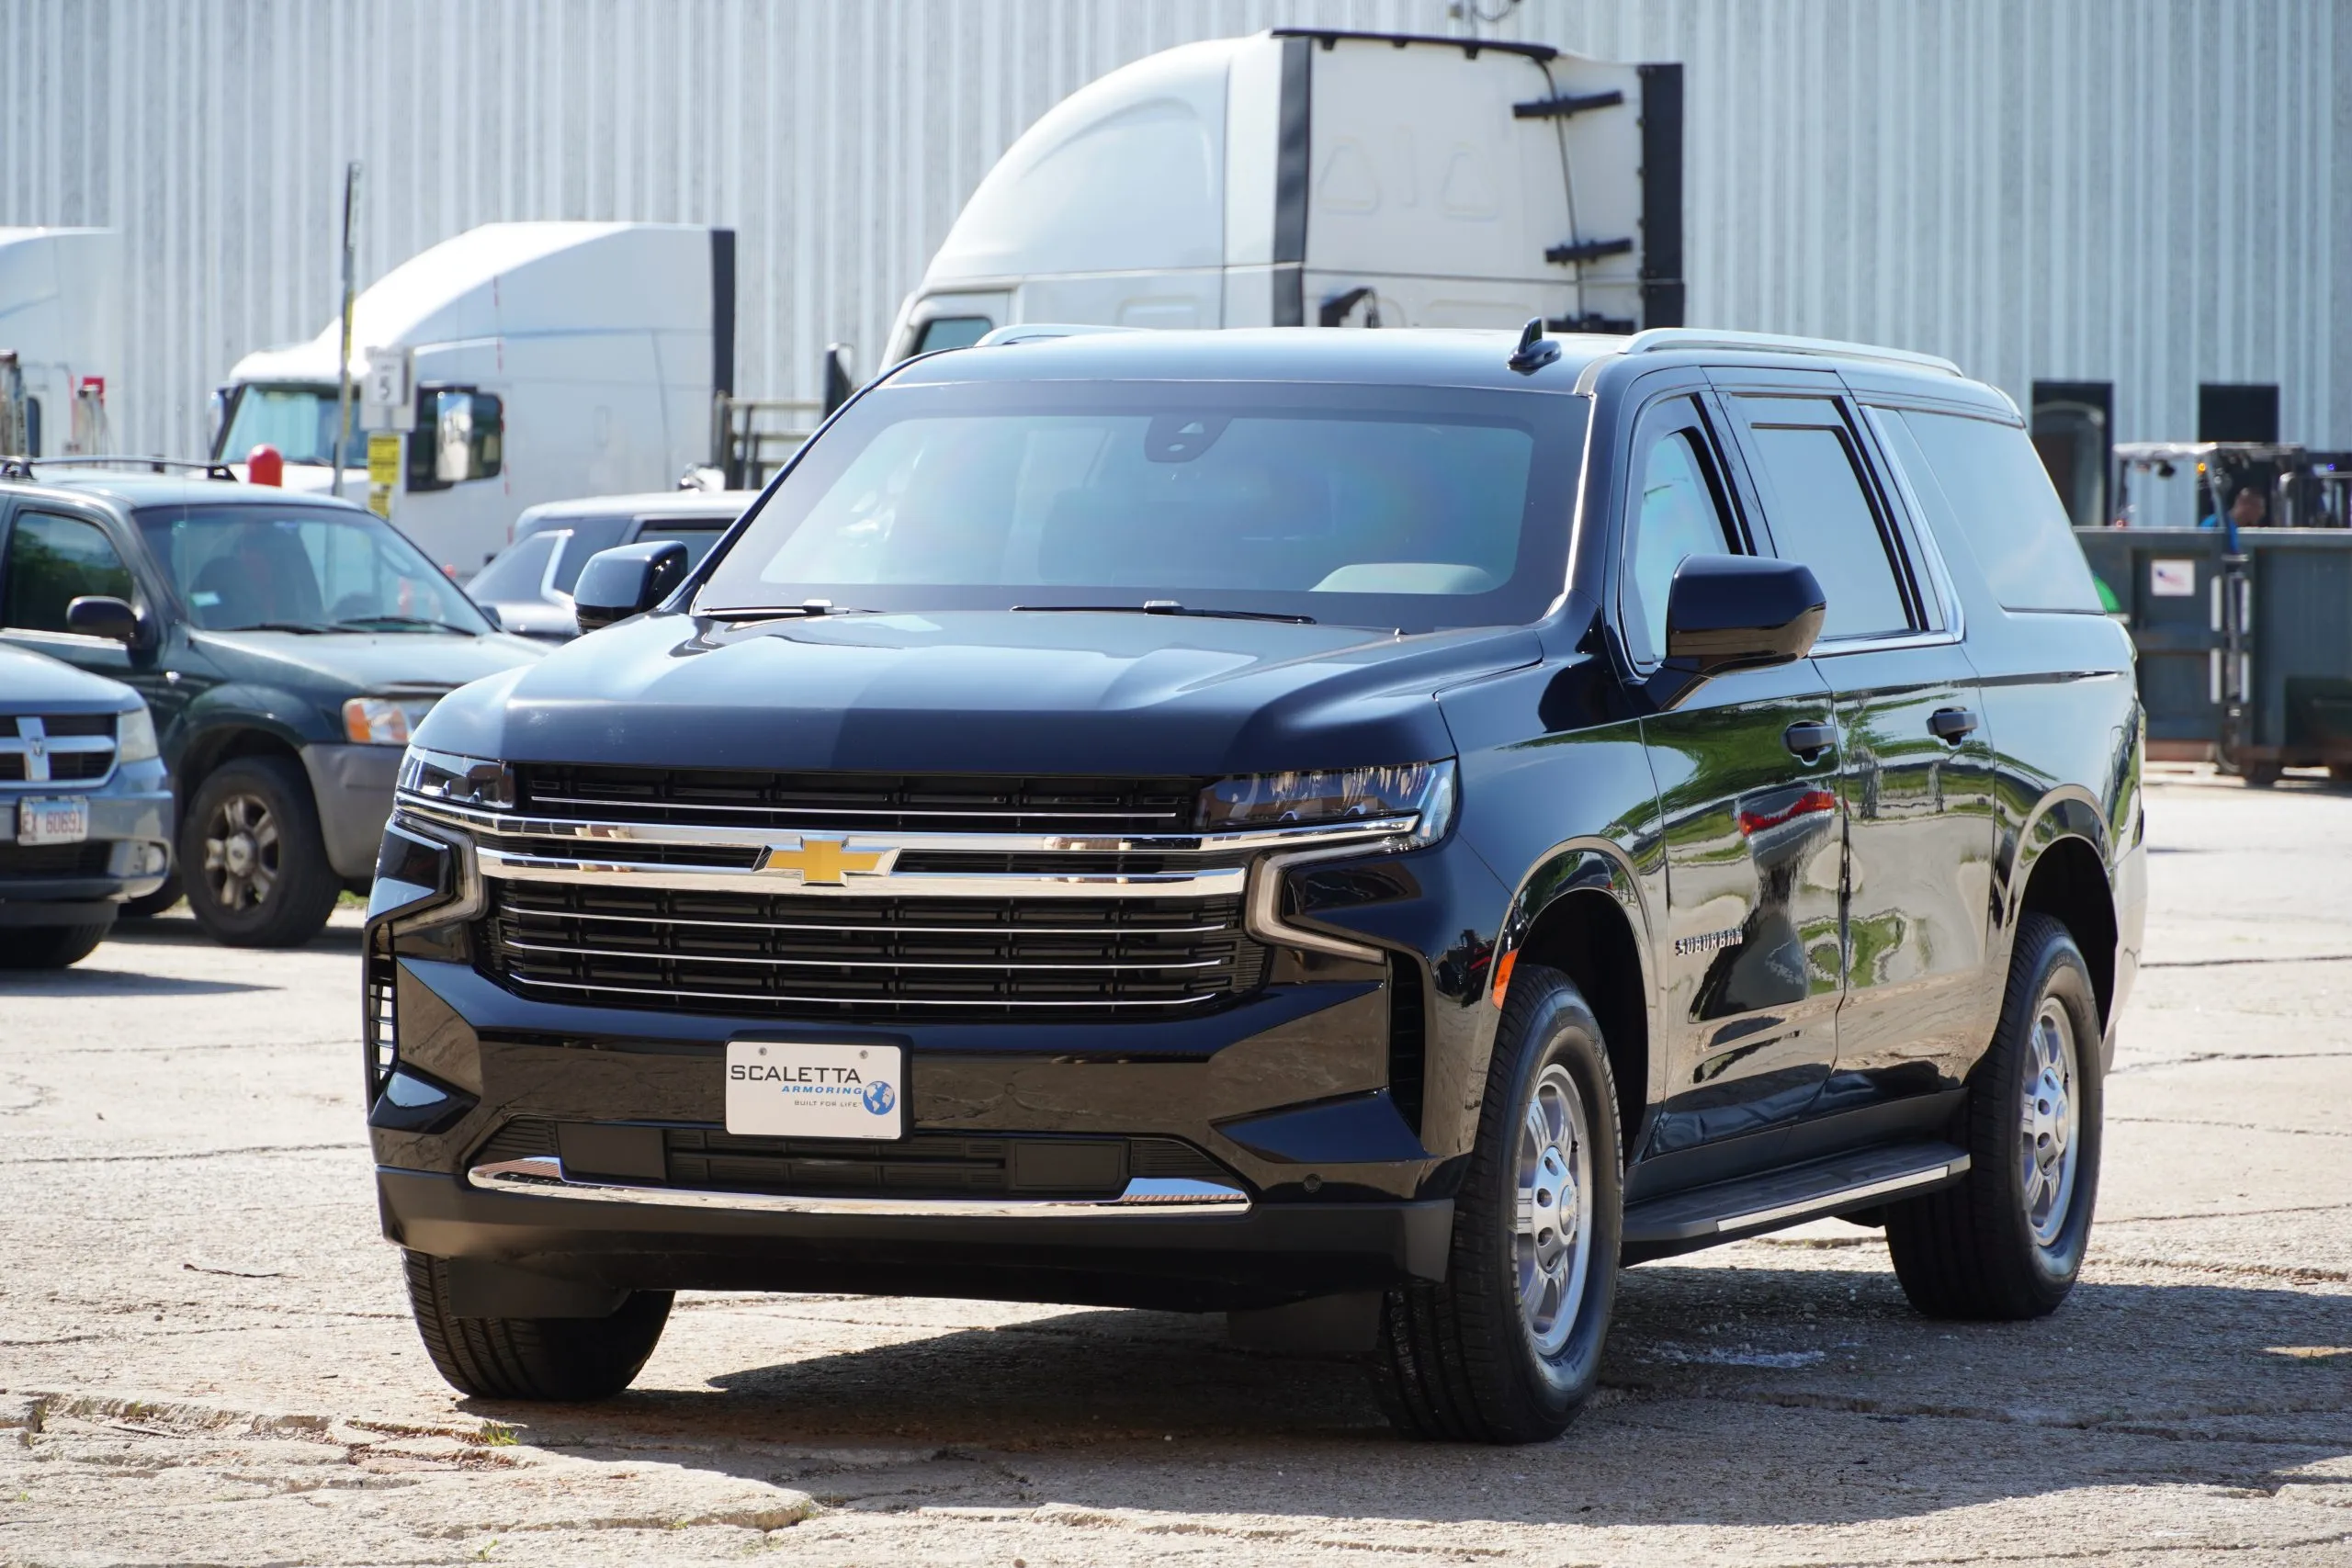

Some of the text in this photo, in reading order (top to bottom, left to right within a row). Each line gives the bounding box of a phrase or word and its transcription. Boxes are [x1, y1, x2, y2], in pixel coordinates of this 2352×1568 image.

[1675, 927, 1744, 956] SUBURBAN
[729, 1065, 862, 1084] SCALETTA
[781, 1085, 863, 1095] ARMORING
